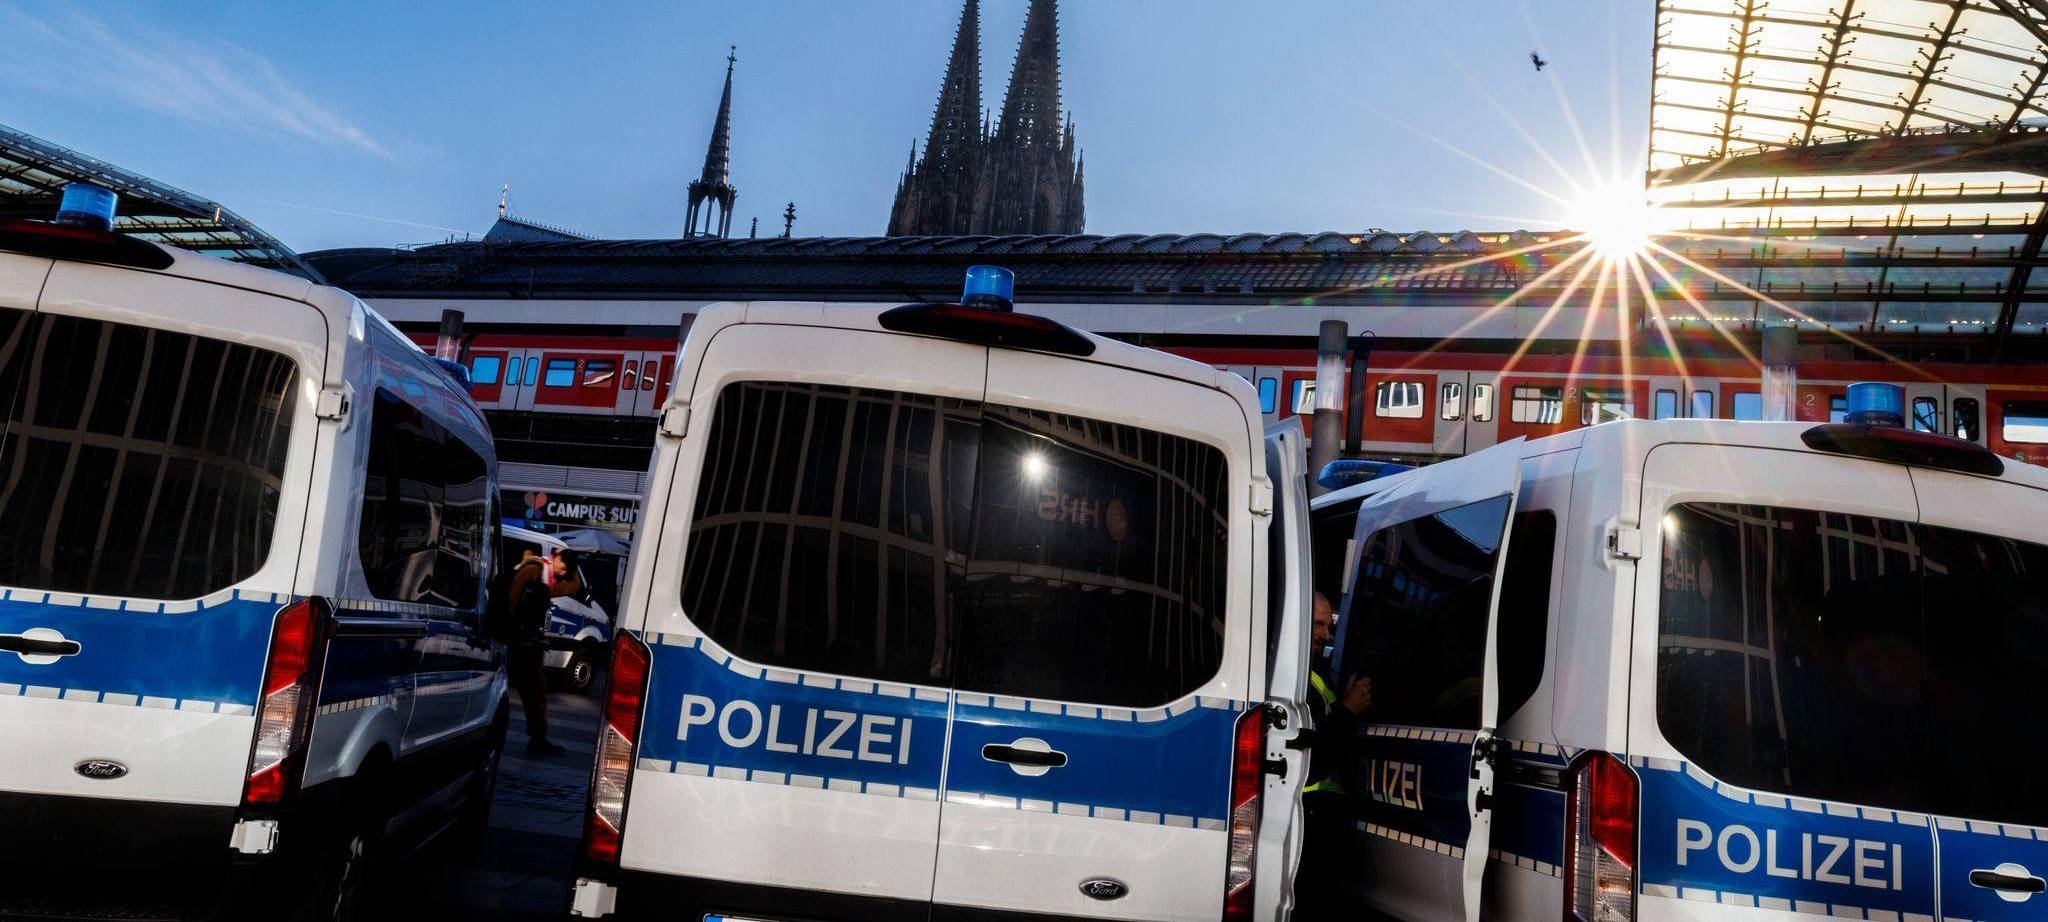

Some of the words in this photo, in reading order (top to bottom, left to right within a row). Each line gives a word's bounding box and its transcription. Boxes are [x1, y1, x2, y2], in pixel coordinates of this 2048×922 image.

[1806, 394, 1815, 406] 2
[546, 501, 607, 521] CAMPUS
[676, 694, 912, 765] POLIZEI
[85, 761, 116, 776] Ford
[1677, 818, 1902, 891] POLIZEI
[1090, 881, 1119, 896] Ford
